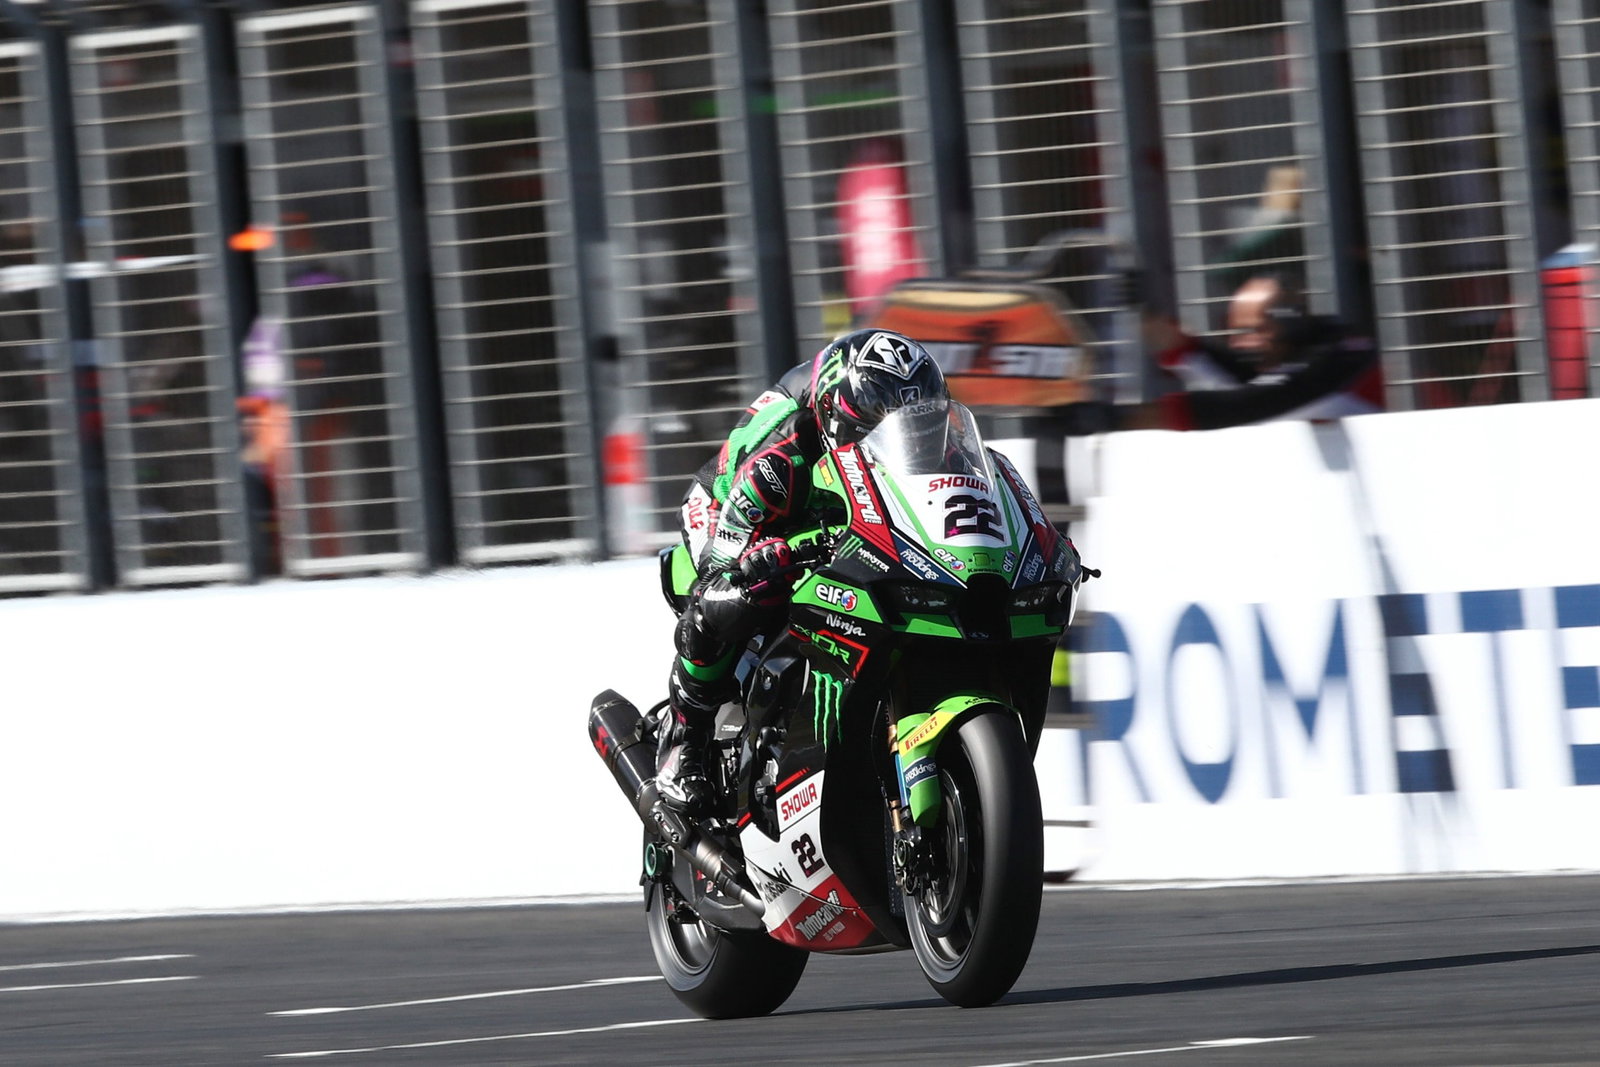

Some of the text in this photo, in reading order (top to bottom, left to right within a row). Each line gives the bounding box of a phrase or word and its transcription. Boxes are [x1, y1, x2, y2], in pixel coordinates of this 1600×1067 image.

[755, 457, 788, 500] RST
[928, 476, 989, 495] SHOWA
[944, 494, 1005, 542] 22
[933, 548, 957, 563] elf
[816, 583, 843, 605] elf
[826, 613, 866, 637] Ninja
[905, 716, 938, 751] PIRELLI
[780, 782, 818, 822] SHOWA
[791, 832, 826, 879] 22
